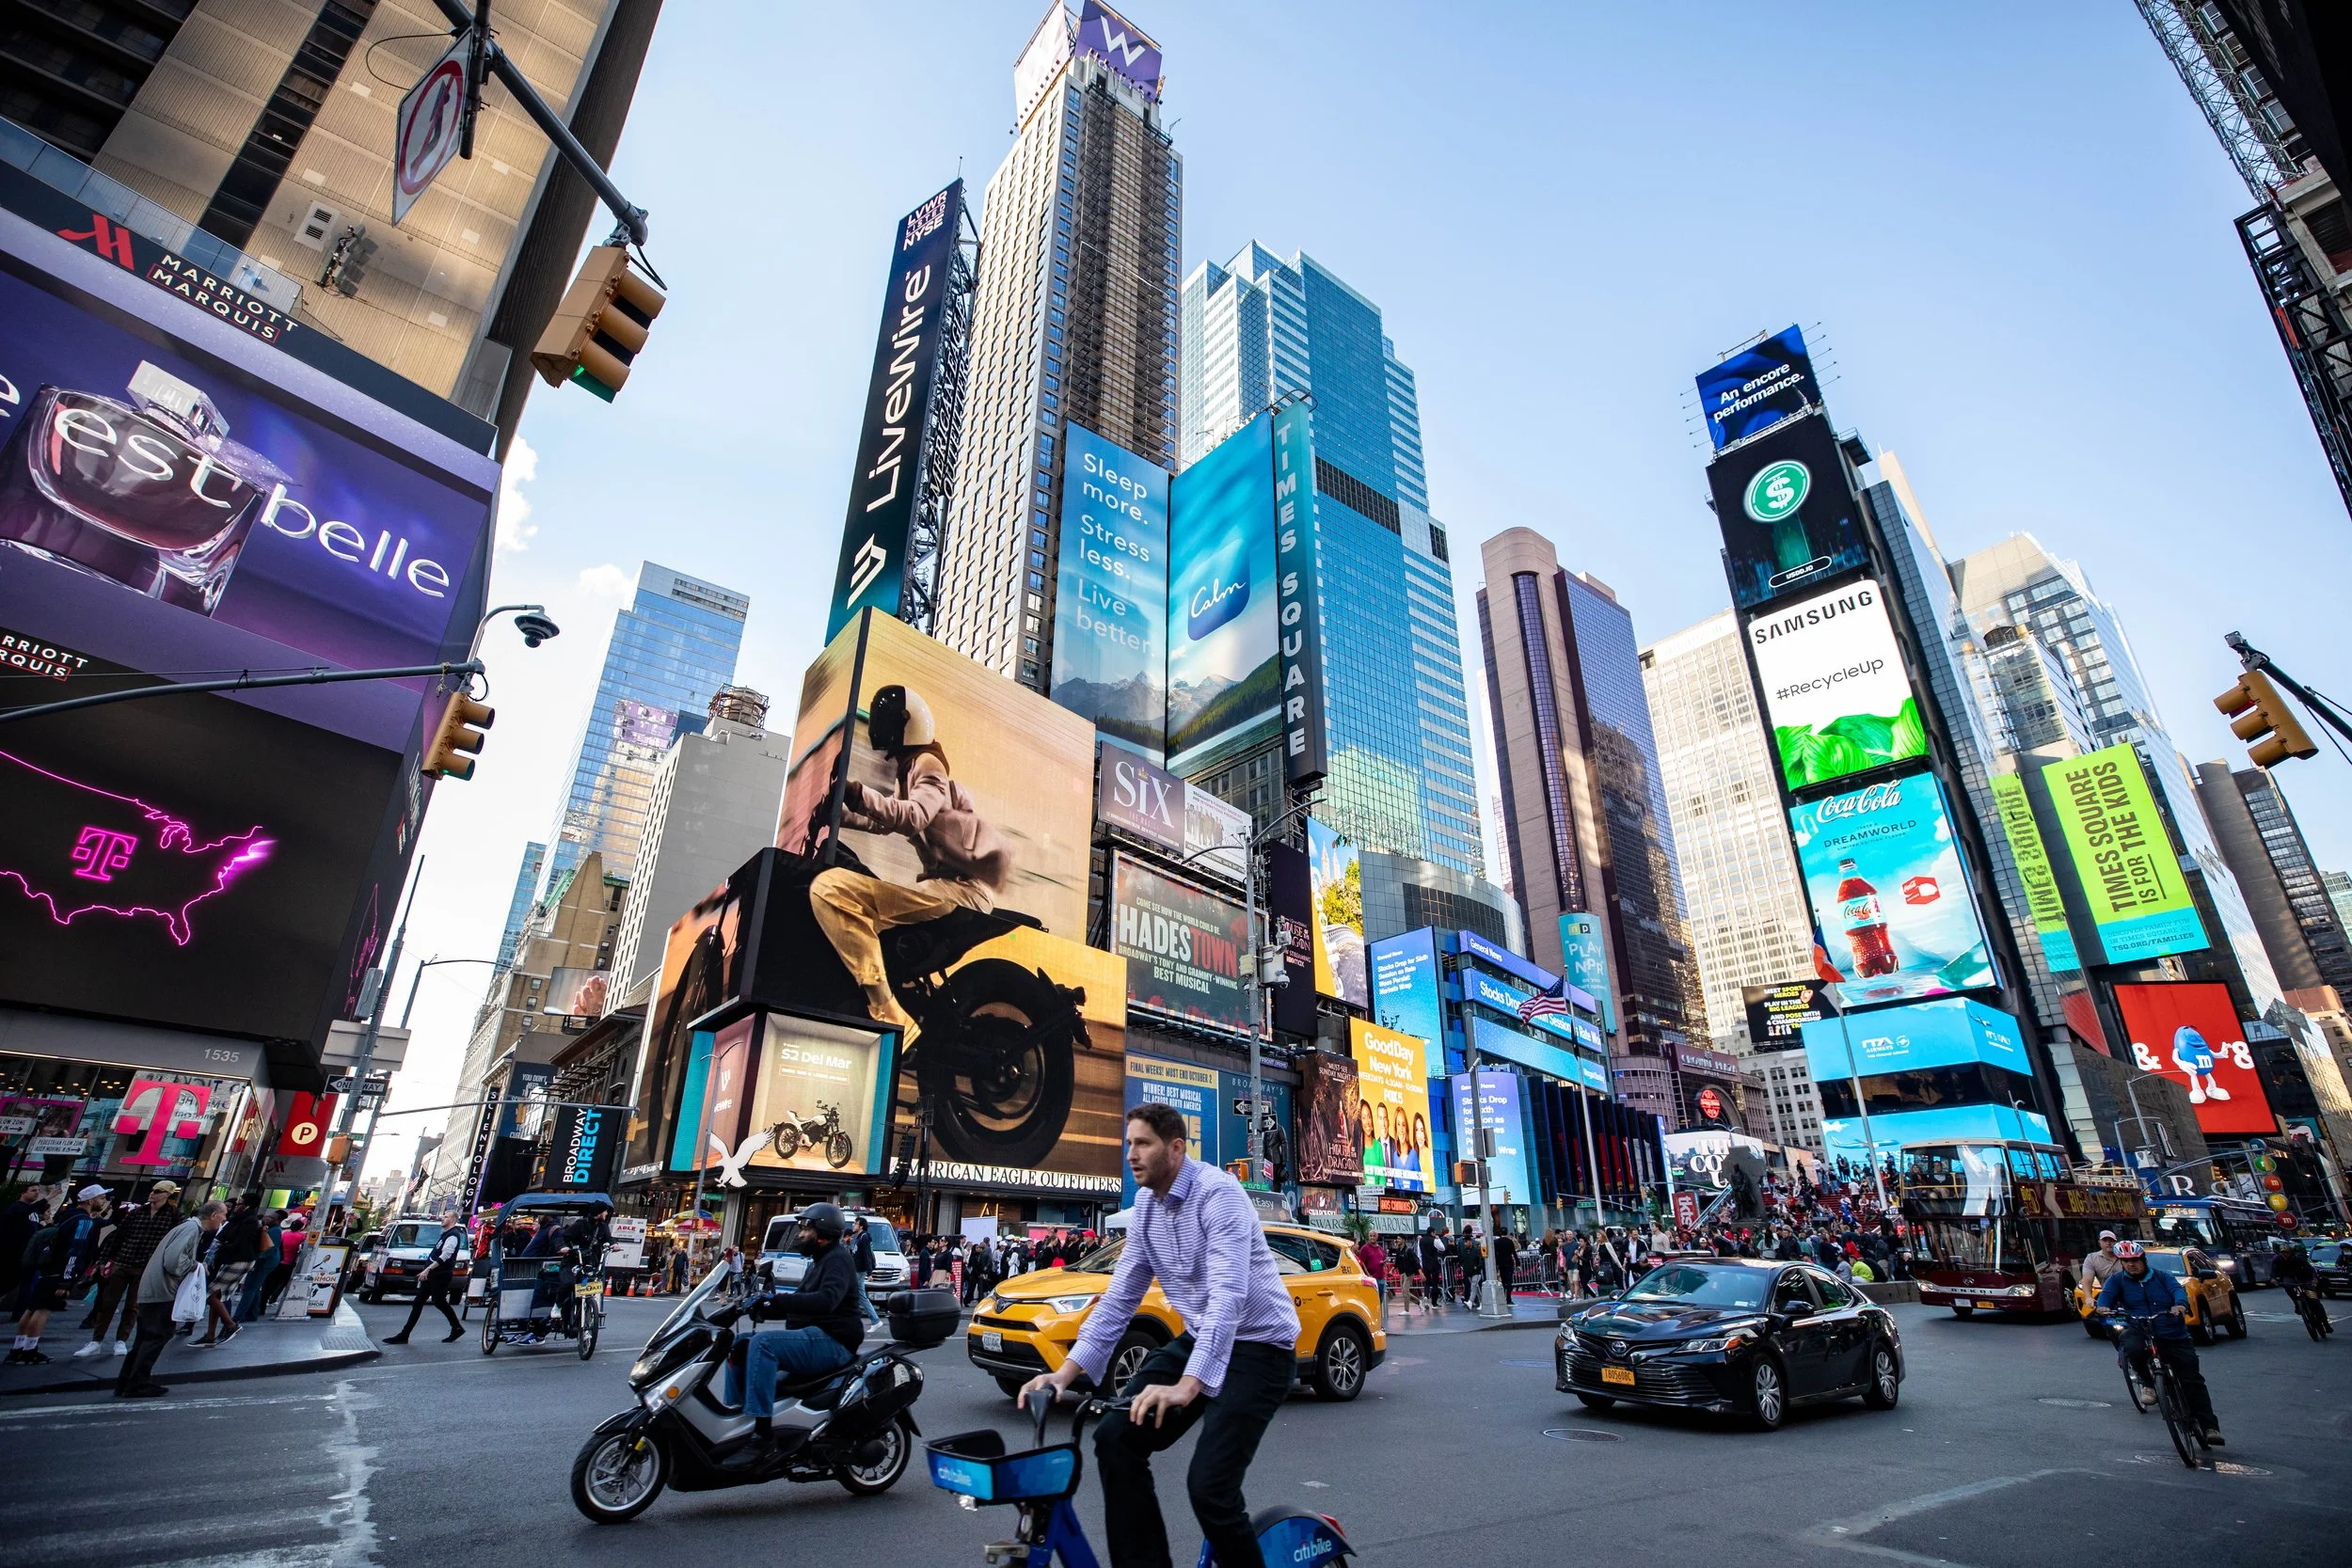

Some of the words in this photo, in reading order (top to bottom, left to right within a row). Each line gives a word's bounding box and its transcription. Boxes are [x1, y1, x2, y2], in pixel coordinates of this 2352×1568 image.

[1100, 14, 1146, 68] W
[906, 203, 946, 236] LISTED
[907, 190, 947, 227] LVWR
[903, 213, 945, 251] NYSE
[152, 268, 275, 340] MARQUIS
[161, 254, 298, 332] MARRIOTT
[1713, 372, 1804, 424] performance.
[1721, 388, 1740, 404] An
[1742, 363, 1790, 392] encore
[929, 374, 955, 519] AMERICAN
[1083, 452, 1148, 502] Sleep
[1277, 422, 1297, 553] TIMES
[55, 407, 243, 509] est
[260, 483, 450, 598] belle
[1083, 481, 1149, 526] more.
[1080, 515, 1150, 562] Stress
[1080, 540, 1131, 579] less.
[1077, 578, 1127, 617] Live
[1190, 578, 1247, 620] Calm
[1076, 606, 1155, 658] better.
[1755, 590, 1874, 645] SAMSUNG
[1281, 571, 1306, 757] SQUARE
[1775, 657, 1884, 701] #RecycleUp
[2092, 761, 2131, 810] KIDS
[2065, 768, 2114, 847] SQUARE
[1823, 819, 1916, 847] DREAMWORLD
[2111, 812, 2146, 852] THE
[2095, 849, 2137, 912] TIMES
[2127, 855, 2153, 885] FOR
[1136, 896, 1151, 908] COME
[1152, 901, 1161, 913] SEE
[1173, 910, 1183, 921] THE
[1183, 913, 1199, 927] WORLD
[1199, 919, 1213, 932] COULD
[2138, 887, 2159, 904] IS
[2107, 926, 2144, 938] DISCOVER
[2145, 920, 2173, 931] FAMILY
[2120, 933, 2145, 943] TIMES
[2147, 927, 2178, 938] SQUARE
[1119, 944, 1158, 964] BROADWAY'S
[1158, 957, 1174, 970] TONY
[1175, 962, 1187, 974] AND
[1470, 938, 1489, 956] General
[1489, 948, 1502, 962] News
[1153, 966, 1175, 983] BEST
[1175, 972, 1210, 994] MUSICAL
[1480, 981, 1505, 1005] Stocks
[1552, 1014, 1571, 1032] Session
[1772, 1016, 1821, 1025] CHAMPIONSHIP
[203, 1047, 240, 1064] 1535
[781, 1048, 800, 1062] S2
[801, 1052, 823, 1066] Del
[826, 1054, 852, 1069] Mar
[1866, 1045, 1894, 1053] AIRWAYS
[2195, 1054, 2213, 1069] m
[336, 1081, 352, 1089] ONE
[363, 1083, 381, 1091] WAY
[1130, 1061, 1144, 1074] FINAL
[1145, 1065, 1164, 1077] WEEKS!
[1165, 1068, 1179, 1078] MUST
[1180, 1069, 1188, 1079] END
[1188, 1071, 1209, 1084] OCTOBER
[1208, 1074, 1213, 1084] 2
[1319, 1068, 1337, 1077] SUNDAY
[1359, 1072, 1384, 1085] WEEKDAYS
[1142, 1082, 1166, 1095] WINNER!
[1166, 1085, 1179, 1099] BEST
[1180, 1088, 1201, 1103] MUSICAL
[1142, 1094, 1152, 1103] ALL
[1183, 1101, 1201, 1112] AMERICA
[1488, 1096, 1507, 1105] Drop
[113, 1080, 213, 1166] T
[299, 1127, 312, 1140] P
[465, 1091, 498, 1208] SCIENTOLOGY
[563, 1108, 587, 1182] BROADWAY
[573, 1108, 602, 1184] DIRECT
[1498, 1147, 1517, 1155] Wrap
[990, 1166, 1036, 1186] EAGLE
[1040, 1171, 1121, 1193] OUTFITTERS
[2096, 1193, 2116, 1212] NEW
[2116, 1193, 2136, 1212] YORK
[1371, 1215, 1413, 1231] SWAROVSKI
[1294, 1540, 1311, 1562] citi
[1311, 1538, 1332, 1556] bike
